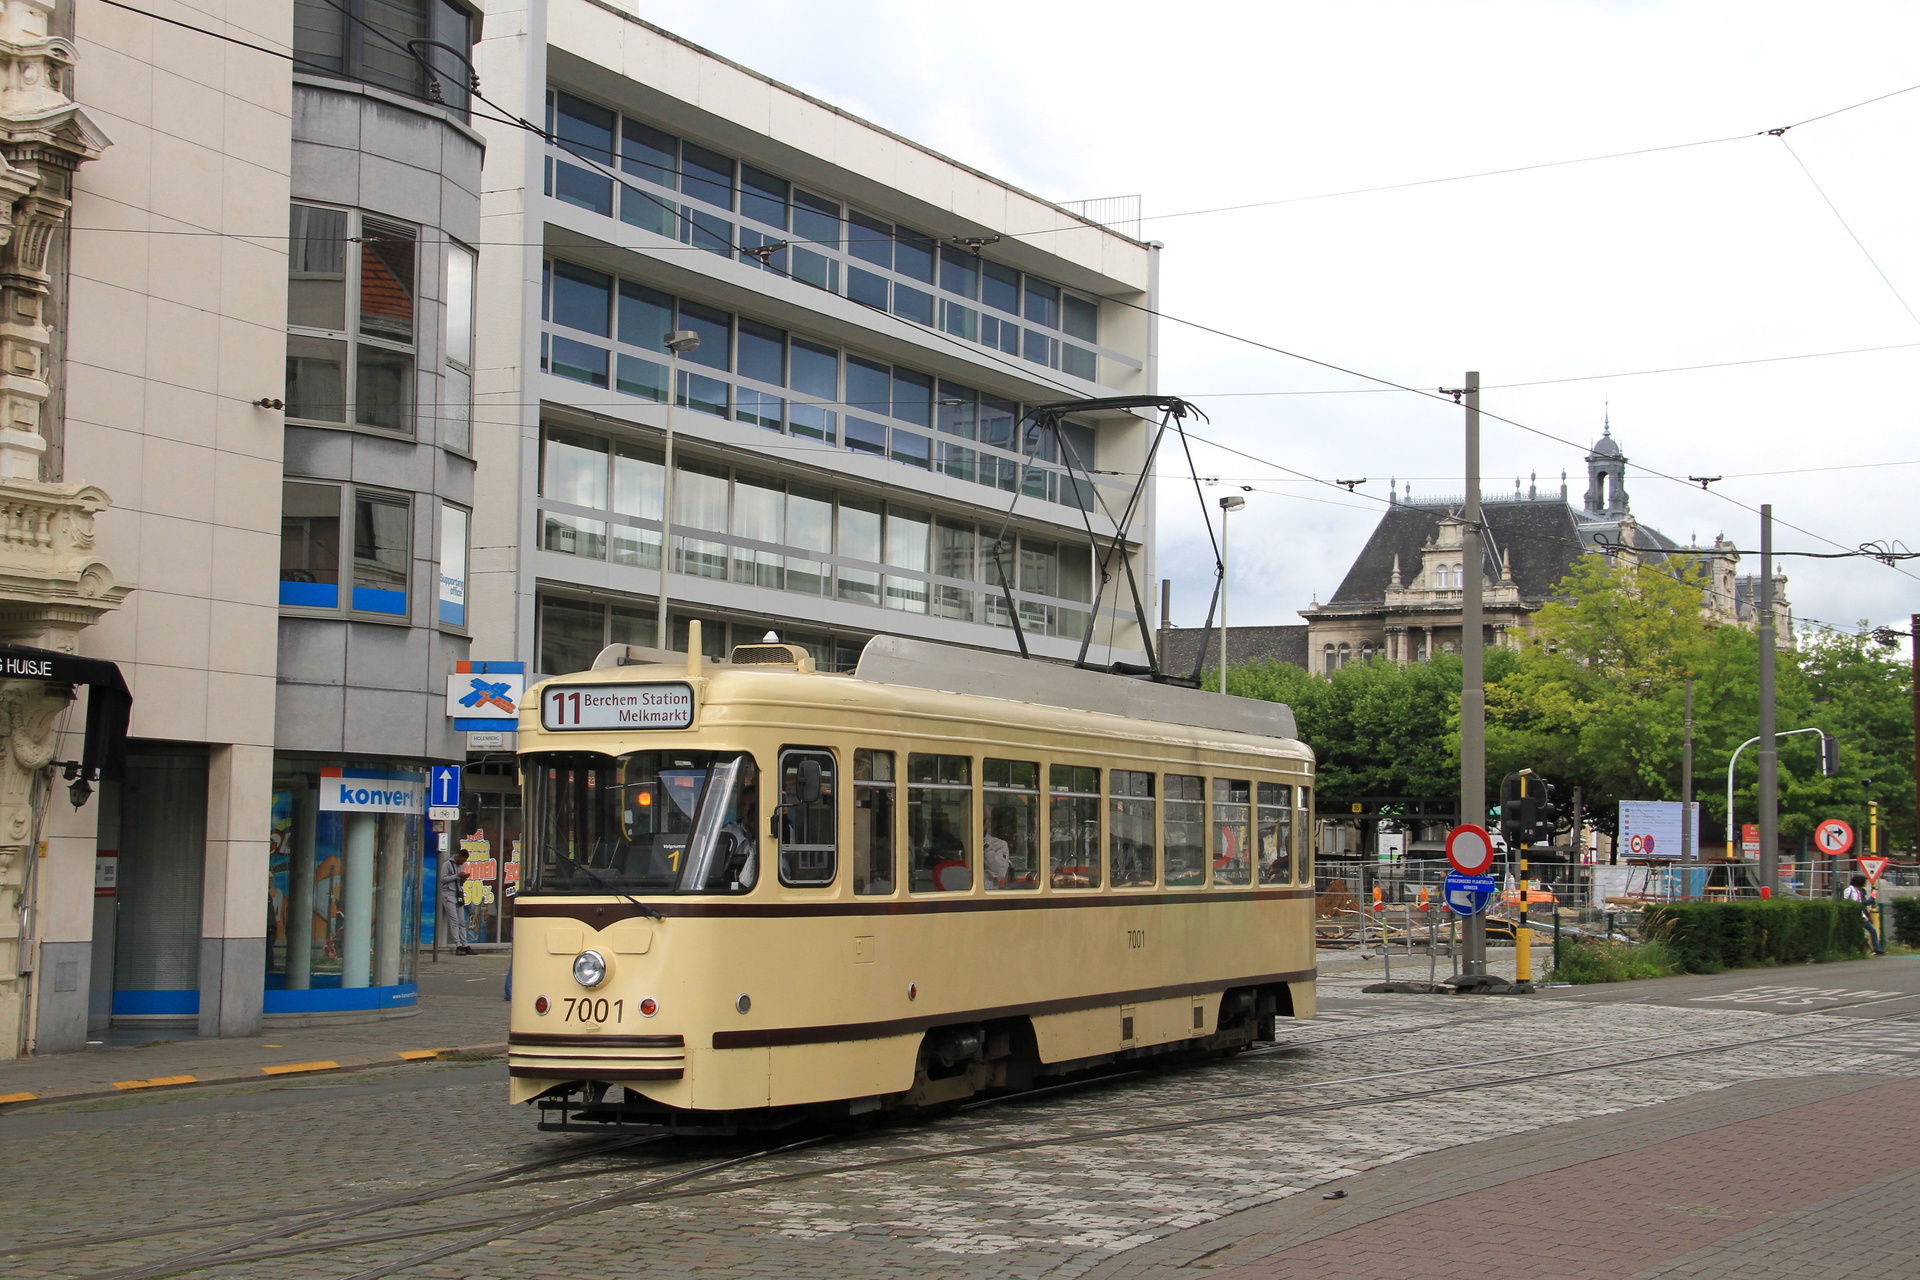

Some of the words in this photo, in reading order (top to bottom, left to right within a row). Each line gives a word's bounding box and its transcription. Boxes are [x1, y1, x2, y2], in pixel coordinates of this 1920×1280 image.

[7, 658, 52, 676] HUISJE
[552, 692, 581, 725] 11
[584, 693, 638, 706] Berchem
[642, 692, 688, 705] Station
[619, 709, 688, 722] Melkmarkt
[340, 784, 414, 807] konvert
[1127, 930, 1145, 949] 7001
[1687, 993, 1839, 1006] BUS
[1732, 985, 1905, 999] TRAM
[563, 997, 624, 1023] 7001
